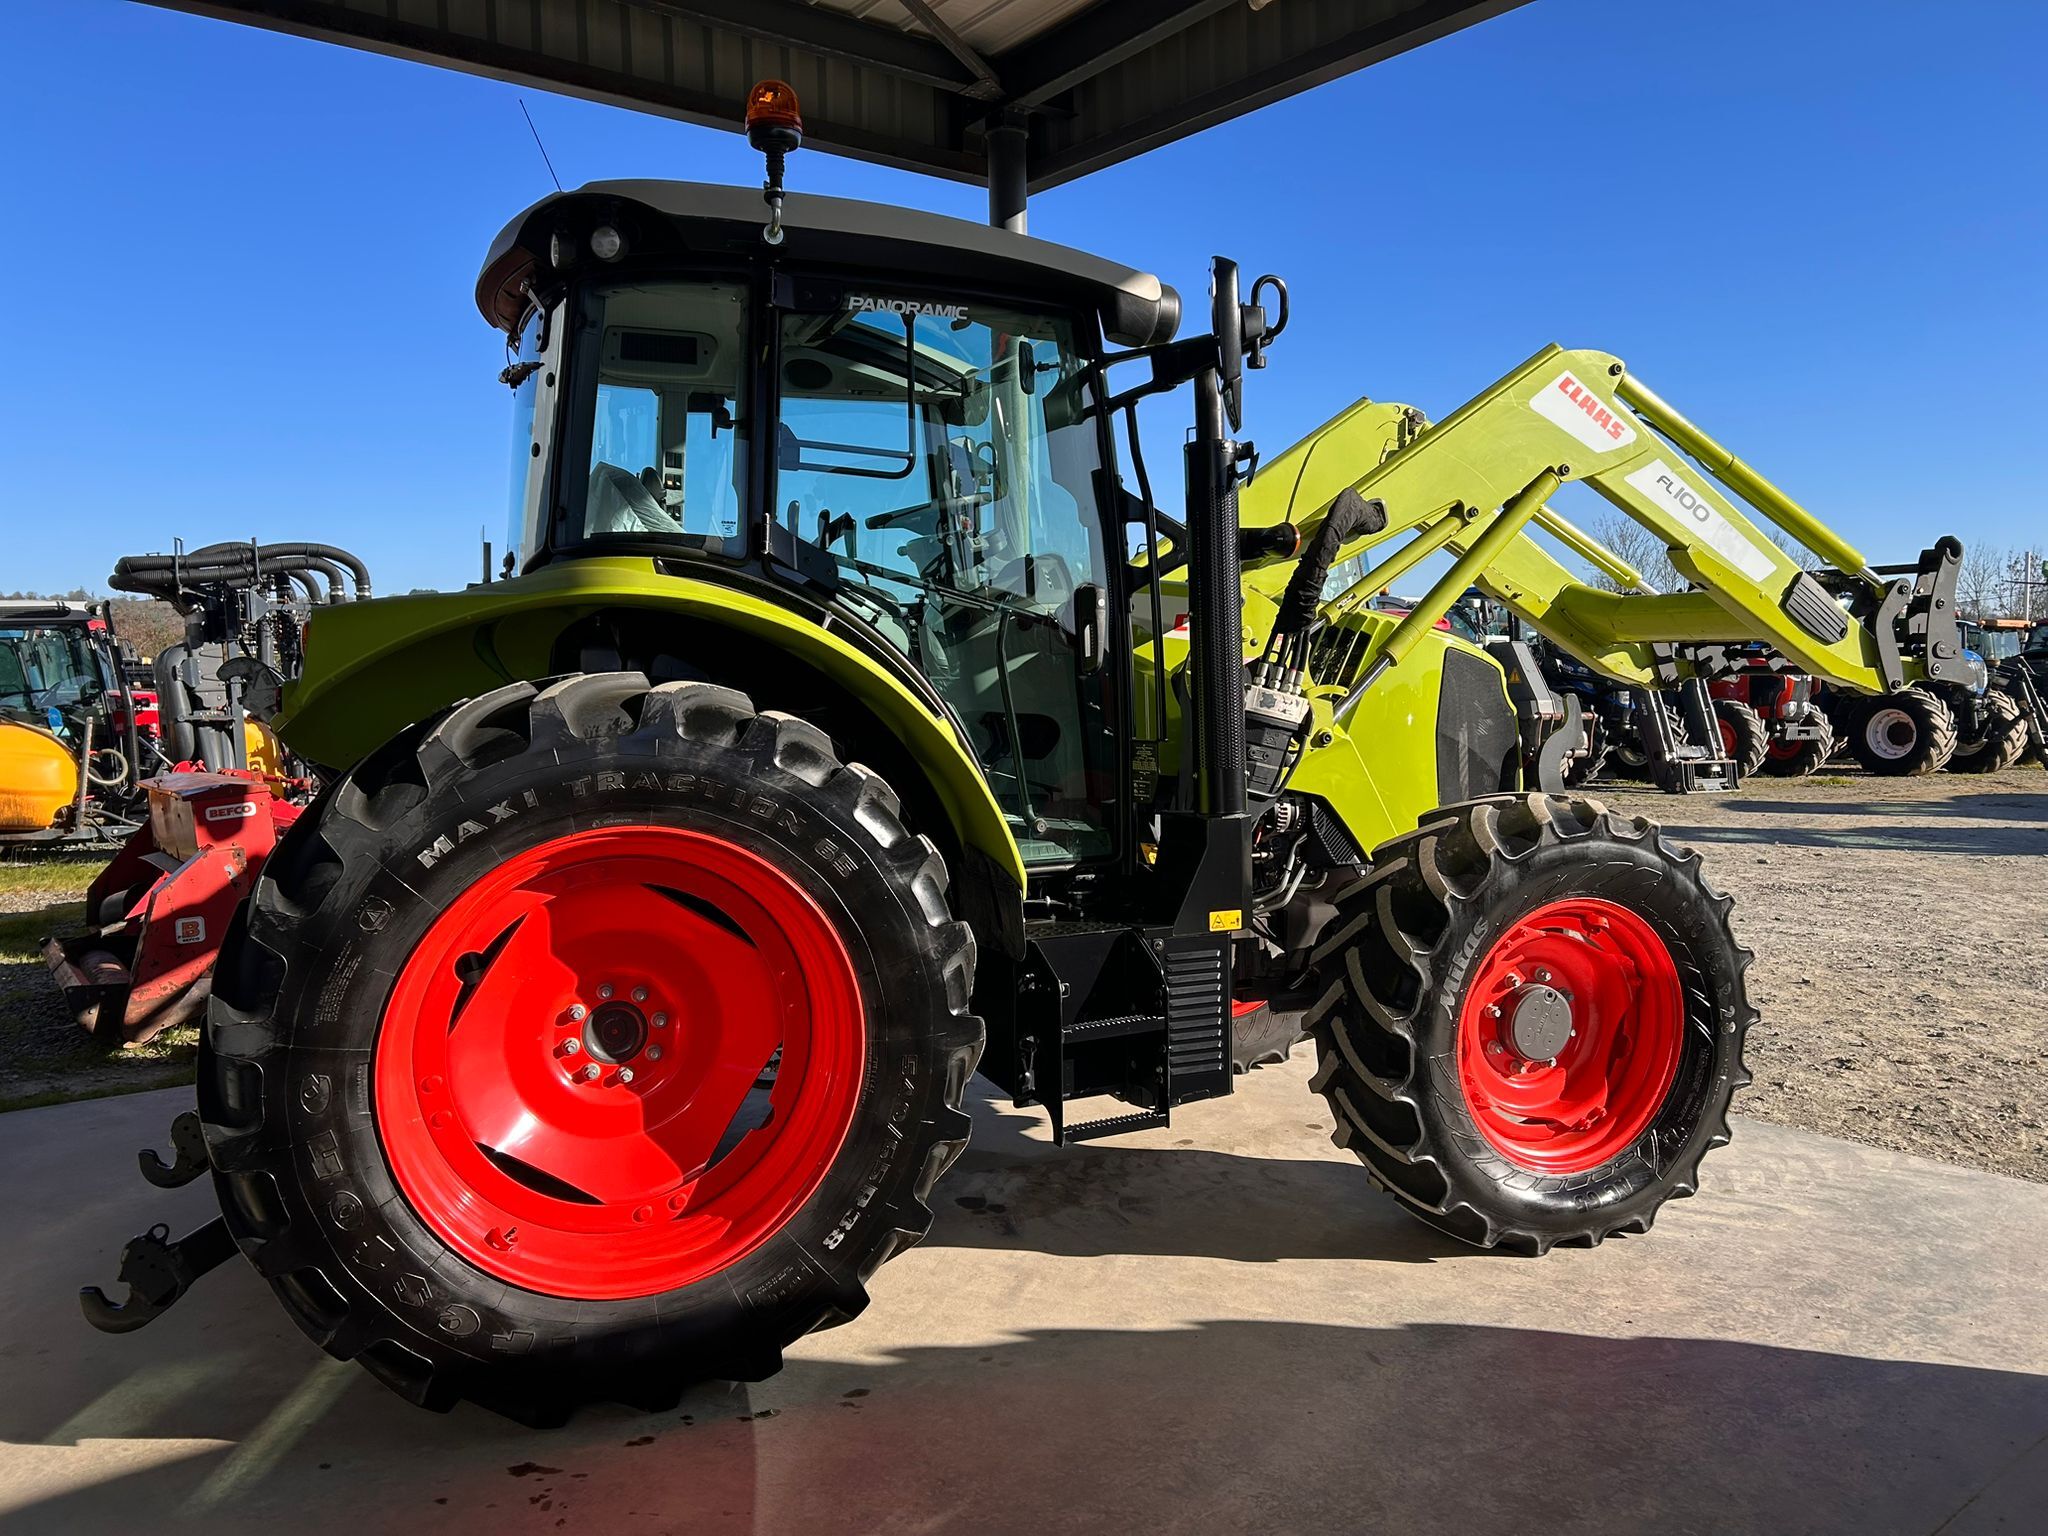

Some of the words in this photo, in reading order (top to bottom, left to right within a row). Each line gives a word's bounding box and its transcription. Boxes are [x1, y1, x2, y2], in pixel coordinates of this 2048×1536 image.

[847, 296, 969, 321] PANORAMIC
[1558, 376, 1625, 440] CLAAS
[1656, 474, 1710, 523] FL100
[209, 804, 252, 819] BEFCO
[417, 788, 539, 869] MAXI
[562, 770, 807, 836] TRACTION
[812, 837, 858, 879] 65
[182, 921, 200, 938] B
[1439, 918, 1490, 1020] Mitas
